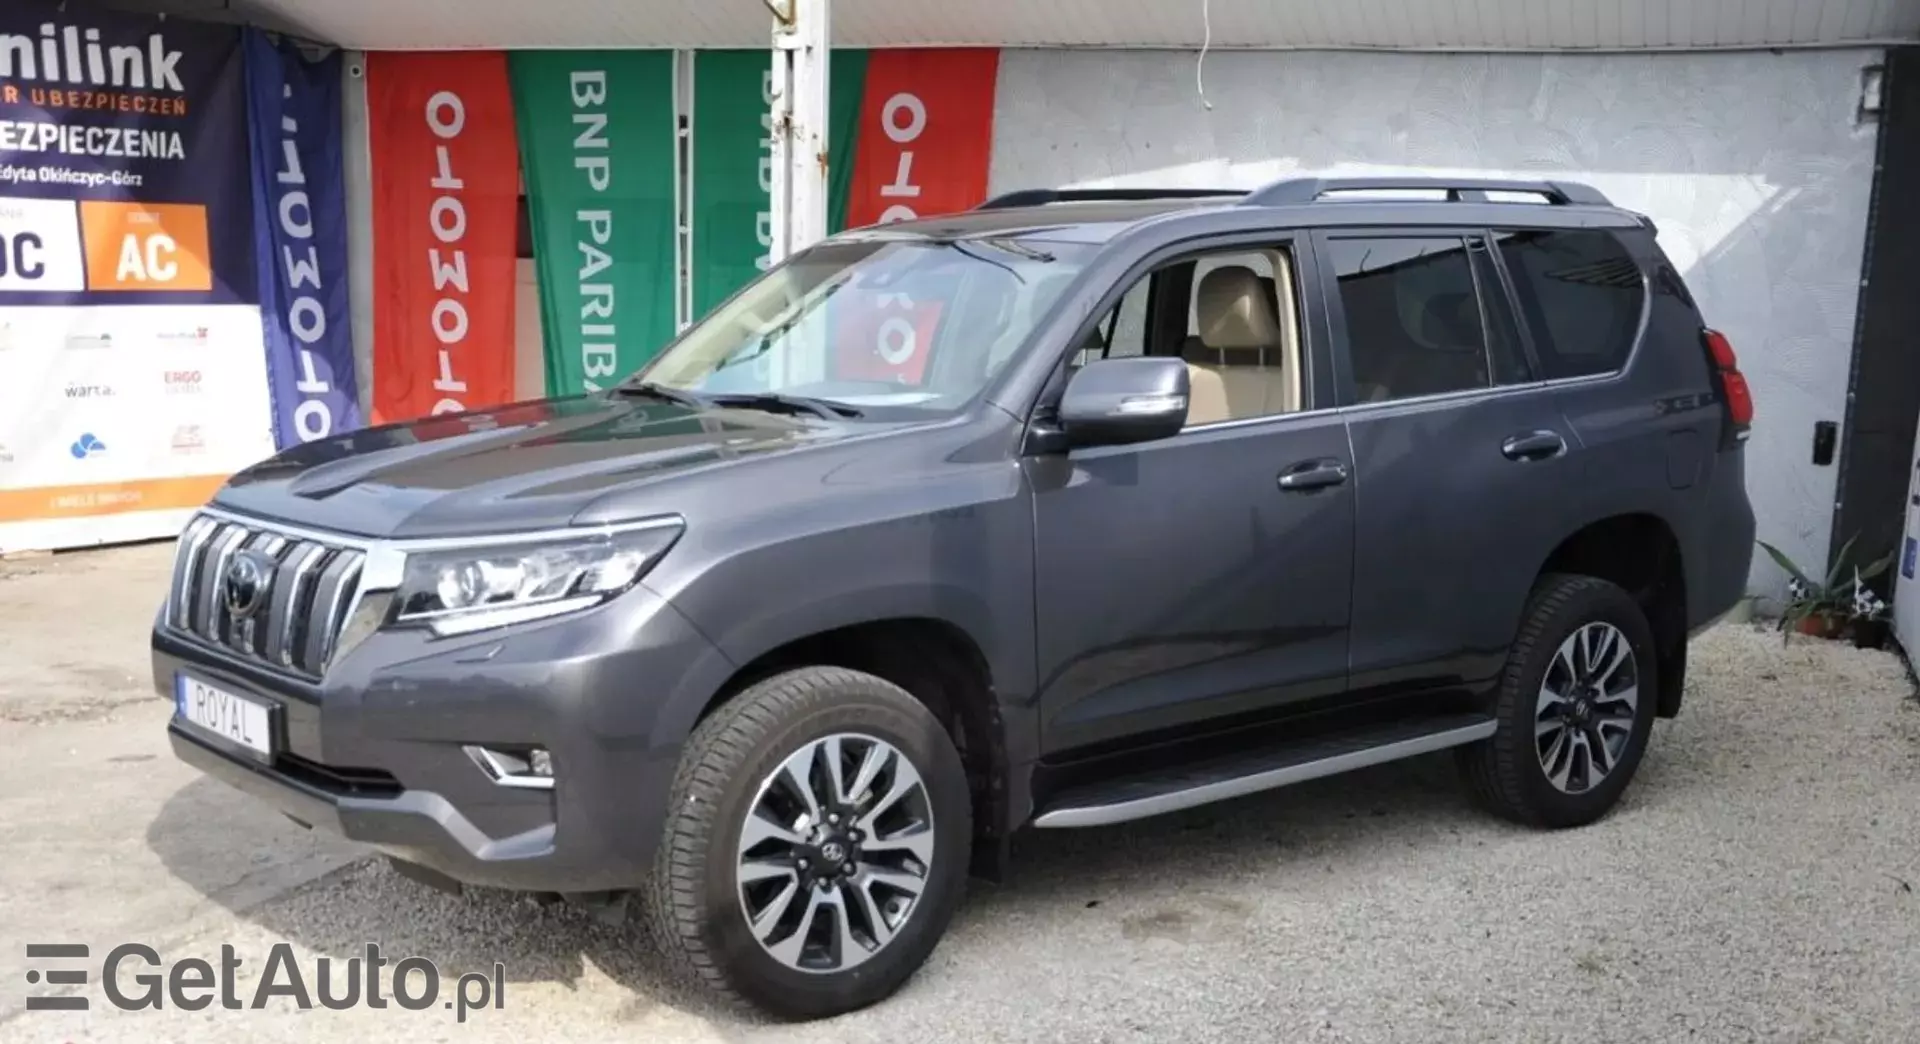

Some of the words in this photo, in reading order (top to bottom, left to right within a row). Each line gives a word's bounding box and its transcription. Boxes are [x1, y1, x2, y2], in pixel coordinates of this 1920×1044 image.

[0, 23, 184, 92] nilink
[31, 88, 186, 116] UBEZPIECZEŃ
[0, 120, 185, 160] EZPIECZENIA
[570, 70, 609, 191] BNP
[0, 231, 45, 280] C
[116, 233, 178, 282] AC
[277, 84, 332, 442] OTOMOT
[164, 370, 202, 384] ERGO
[196, 683, 253, 744] ROYAL
